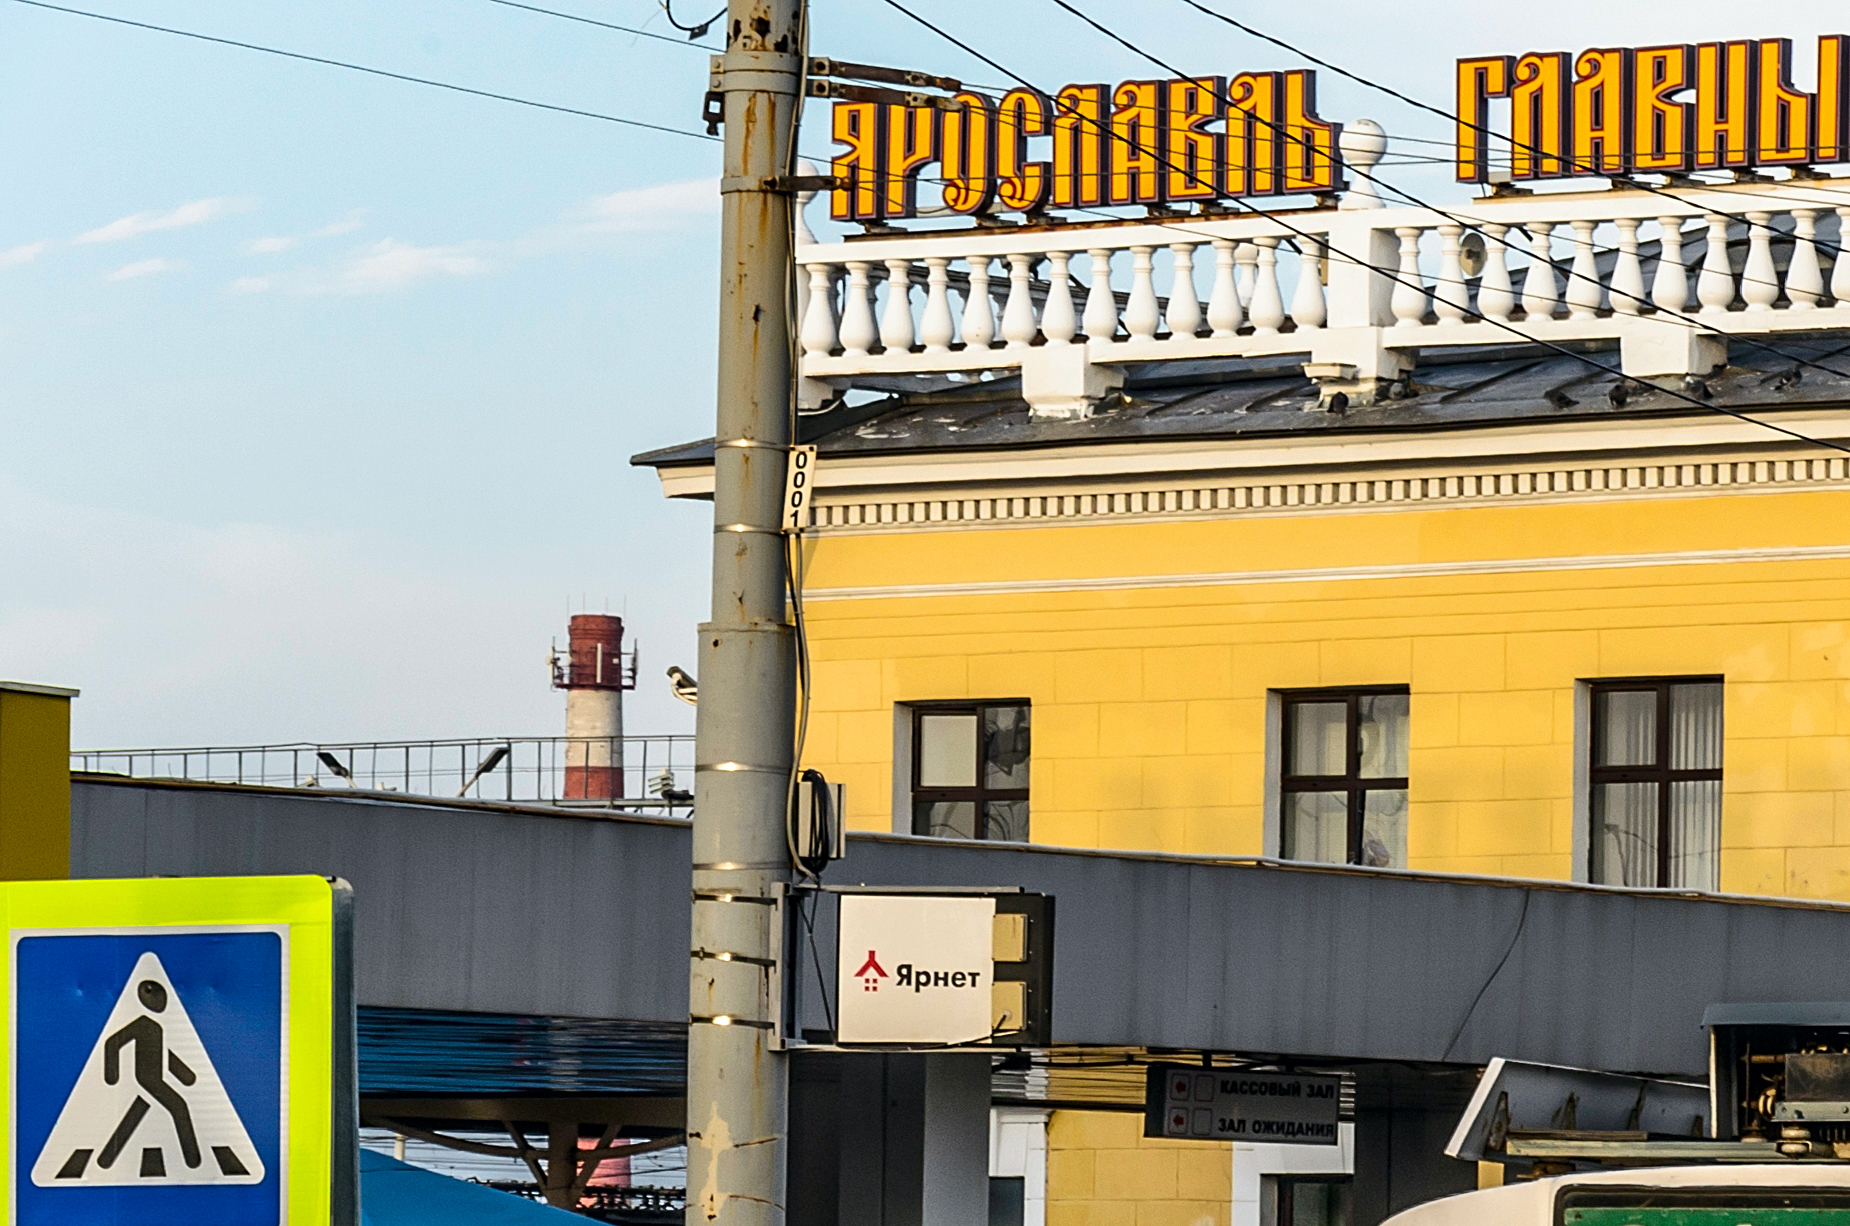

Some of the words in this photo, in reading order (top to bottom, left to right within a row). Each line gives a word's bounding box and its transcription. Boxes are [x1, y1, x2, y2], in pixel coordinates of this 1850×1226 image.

[831, 69, 1347, 221] ЯРОСЛАВЛЬ
[790, 451, 807, 527] 0001
[896, 964, 980, 993] Ярнет
[1220, 1079, 1302, 1098] КАССОВЫЙ
[1306, 1084, 1334, 1099] ЗАЛ
[1218, 1118, 1246, 1133] ЗАЛ
[1252, 1120, 1334, 1138] ОЖИДАНИЯ
